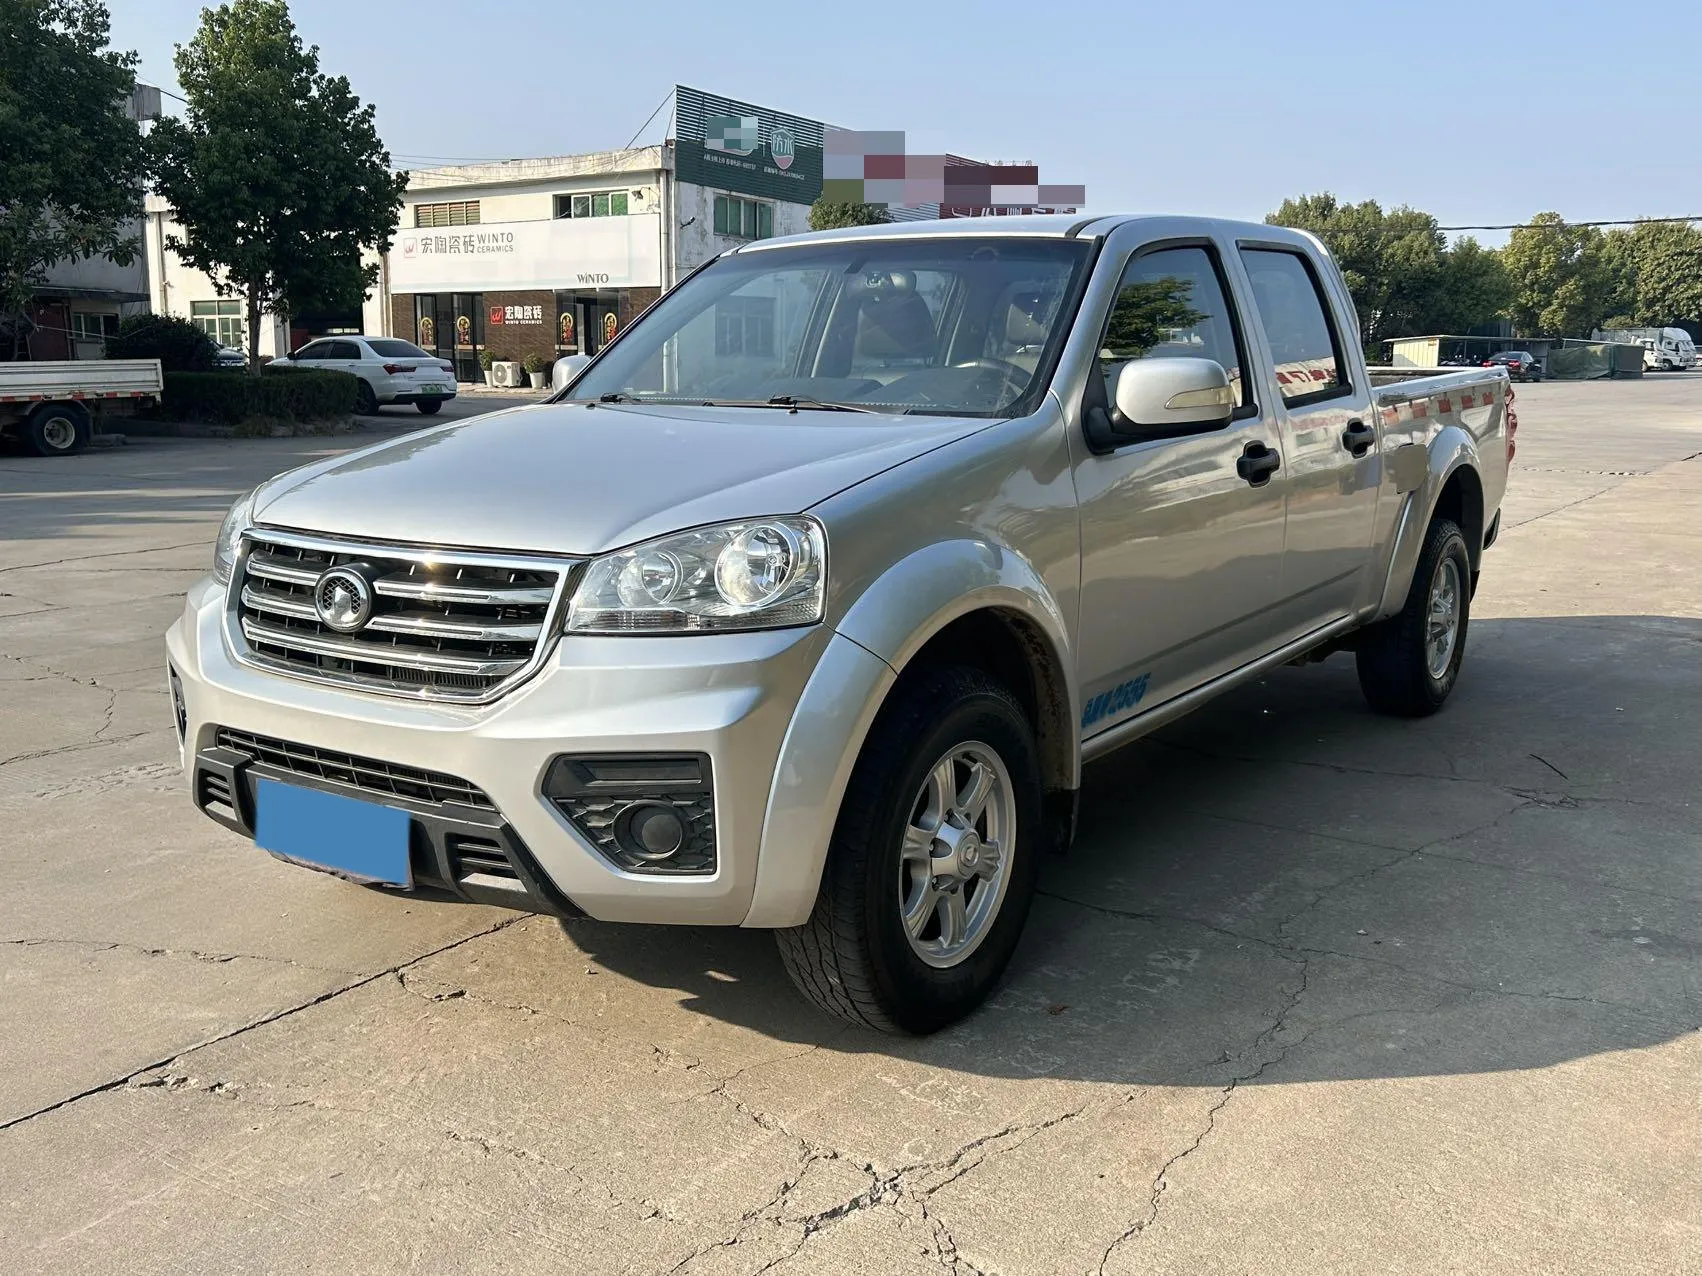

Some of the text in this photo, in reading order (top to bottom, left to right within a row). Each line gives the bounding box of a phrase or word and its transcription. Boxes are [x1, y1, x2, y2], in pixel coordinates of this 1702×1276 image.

[477, 232, 514, 243] WINTO
[420, 235, 475, 254] 宏陶瓷砖
[477, 245, 514, 253] CERAMICS
[505, 306, 542, 319] 宏陶瓷砖
